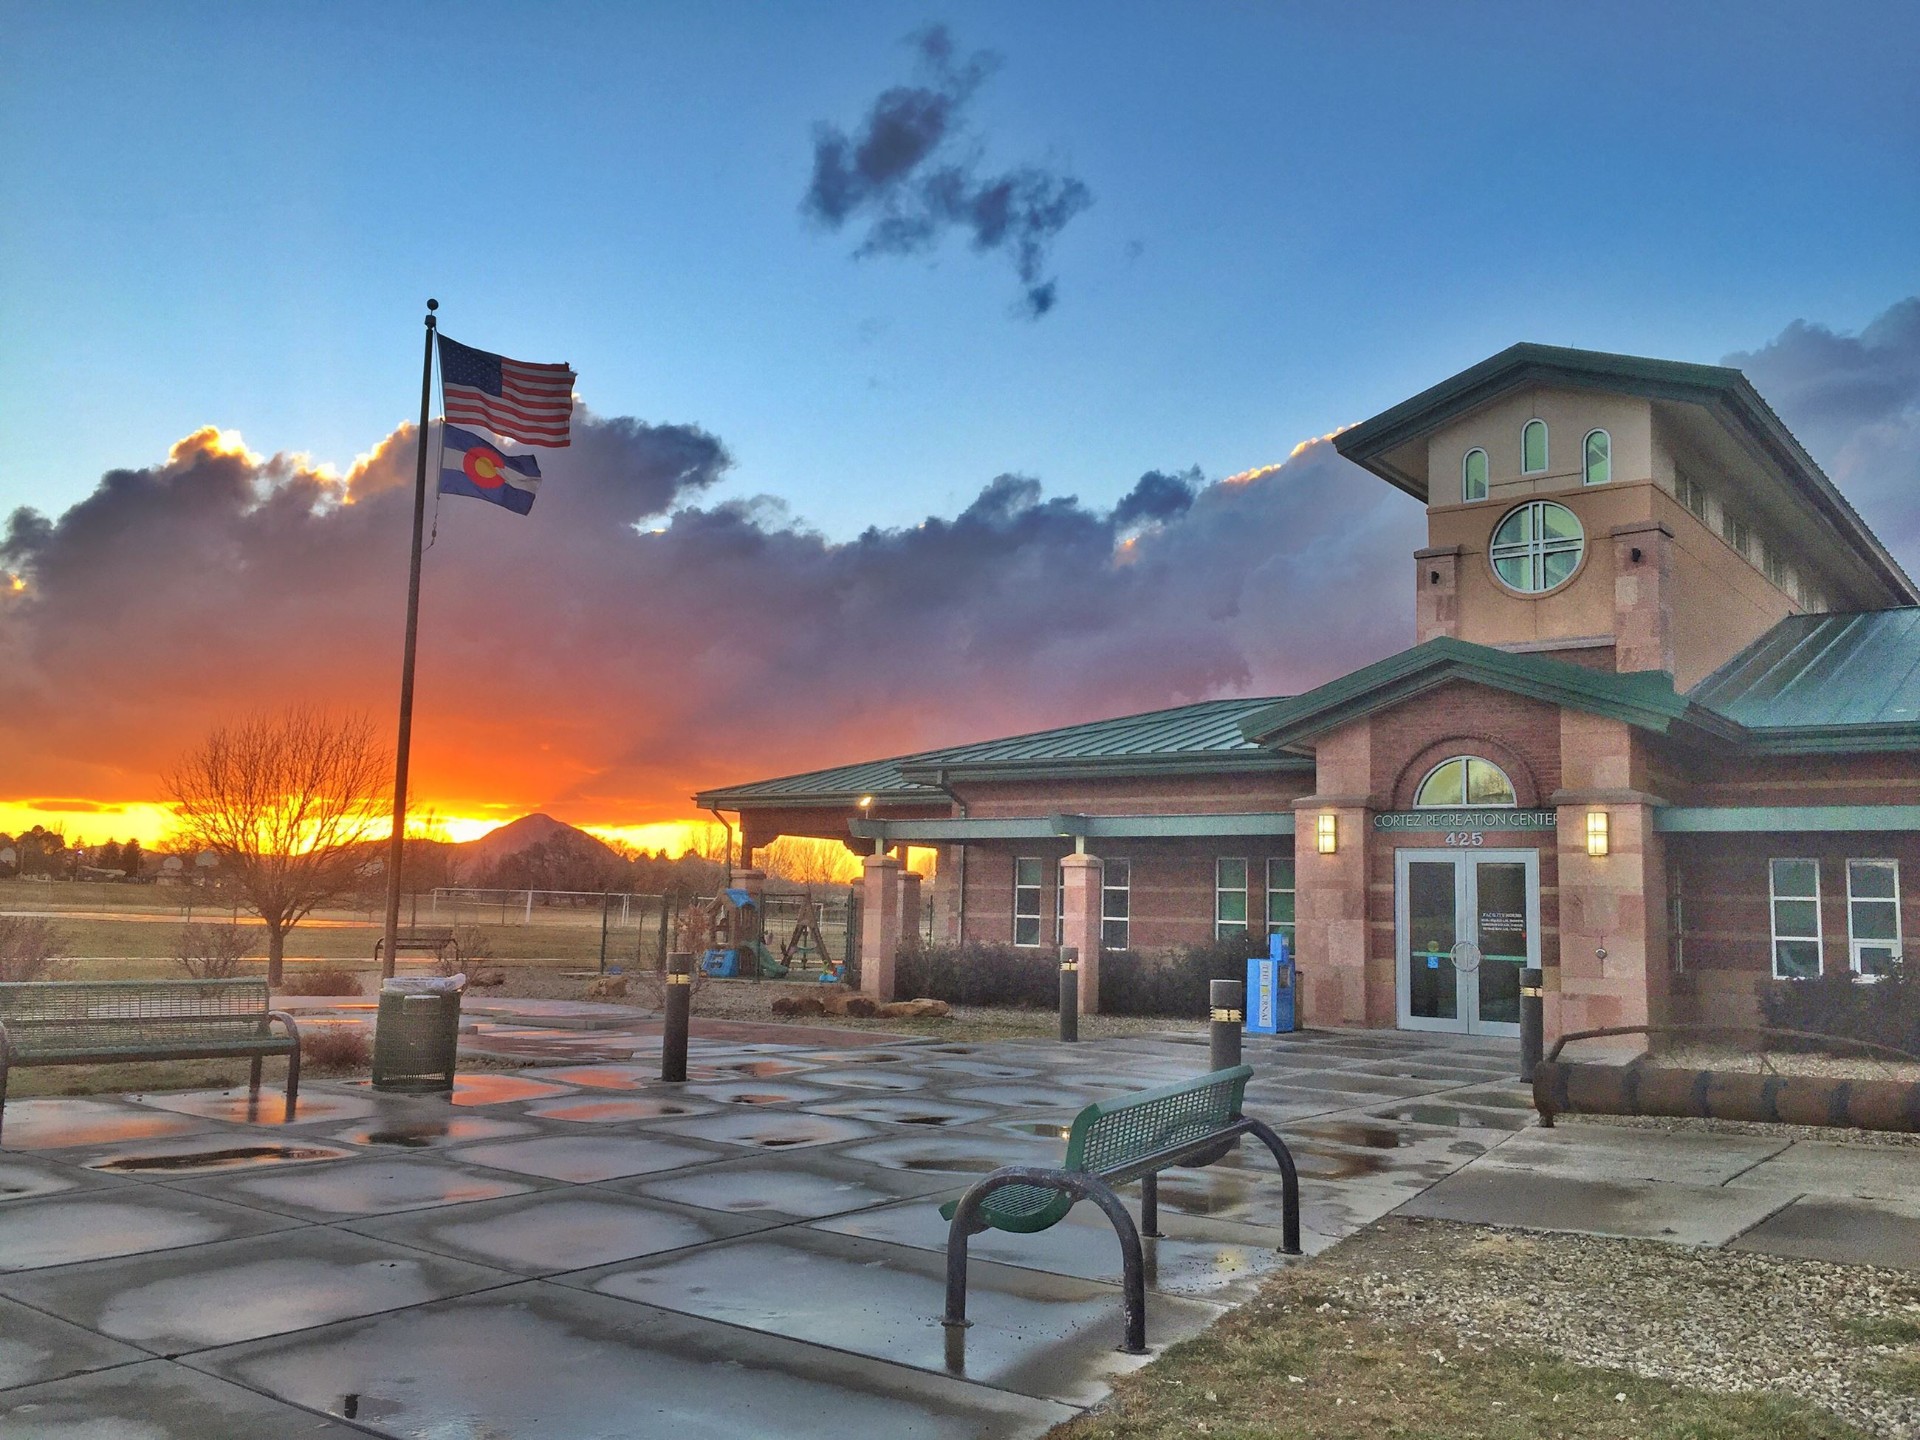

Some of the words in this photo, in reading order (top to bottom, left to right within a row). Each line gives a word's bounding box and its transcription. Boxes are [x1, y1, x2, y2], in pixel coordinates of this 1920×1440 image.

[1373, 814, 1422, 828] CORTEZ
[1426, 813, 1506, 827] RECREATION
[1445, 832, 1484, 847] 425
